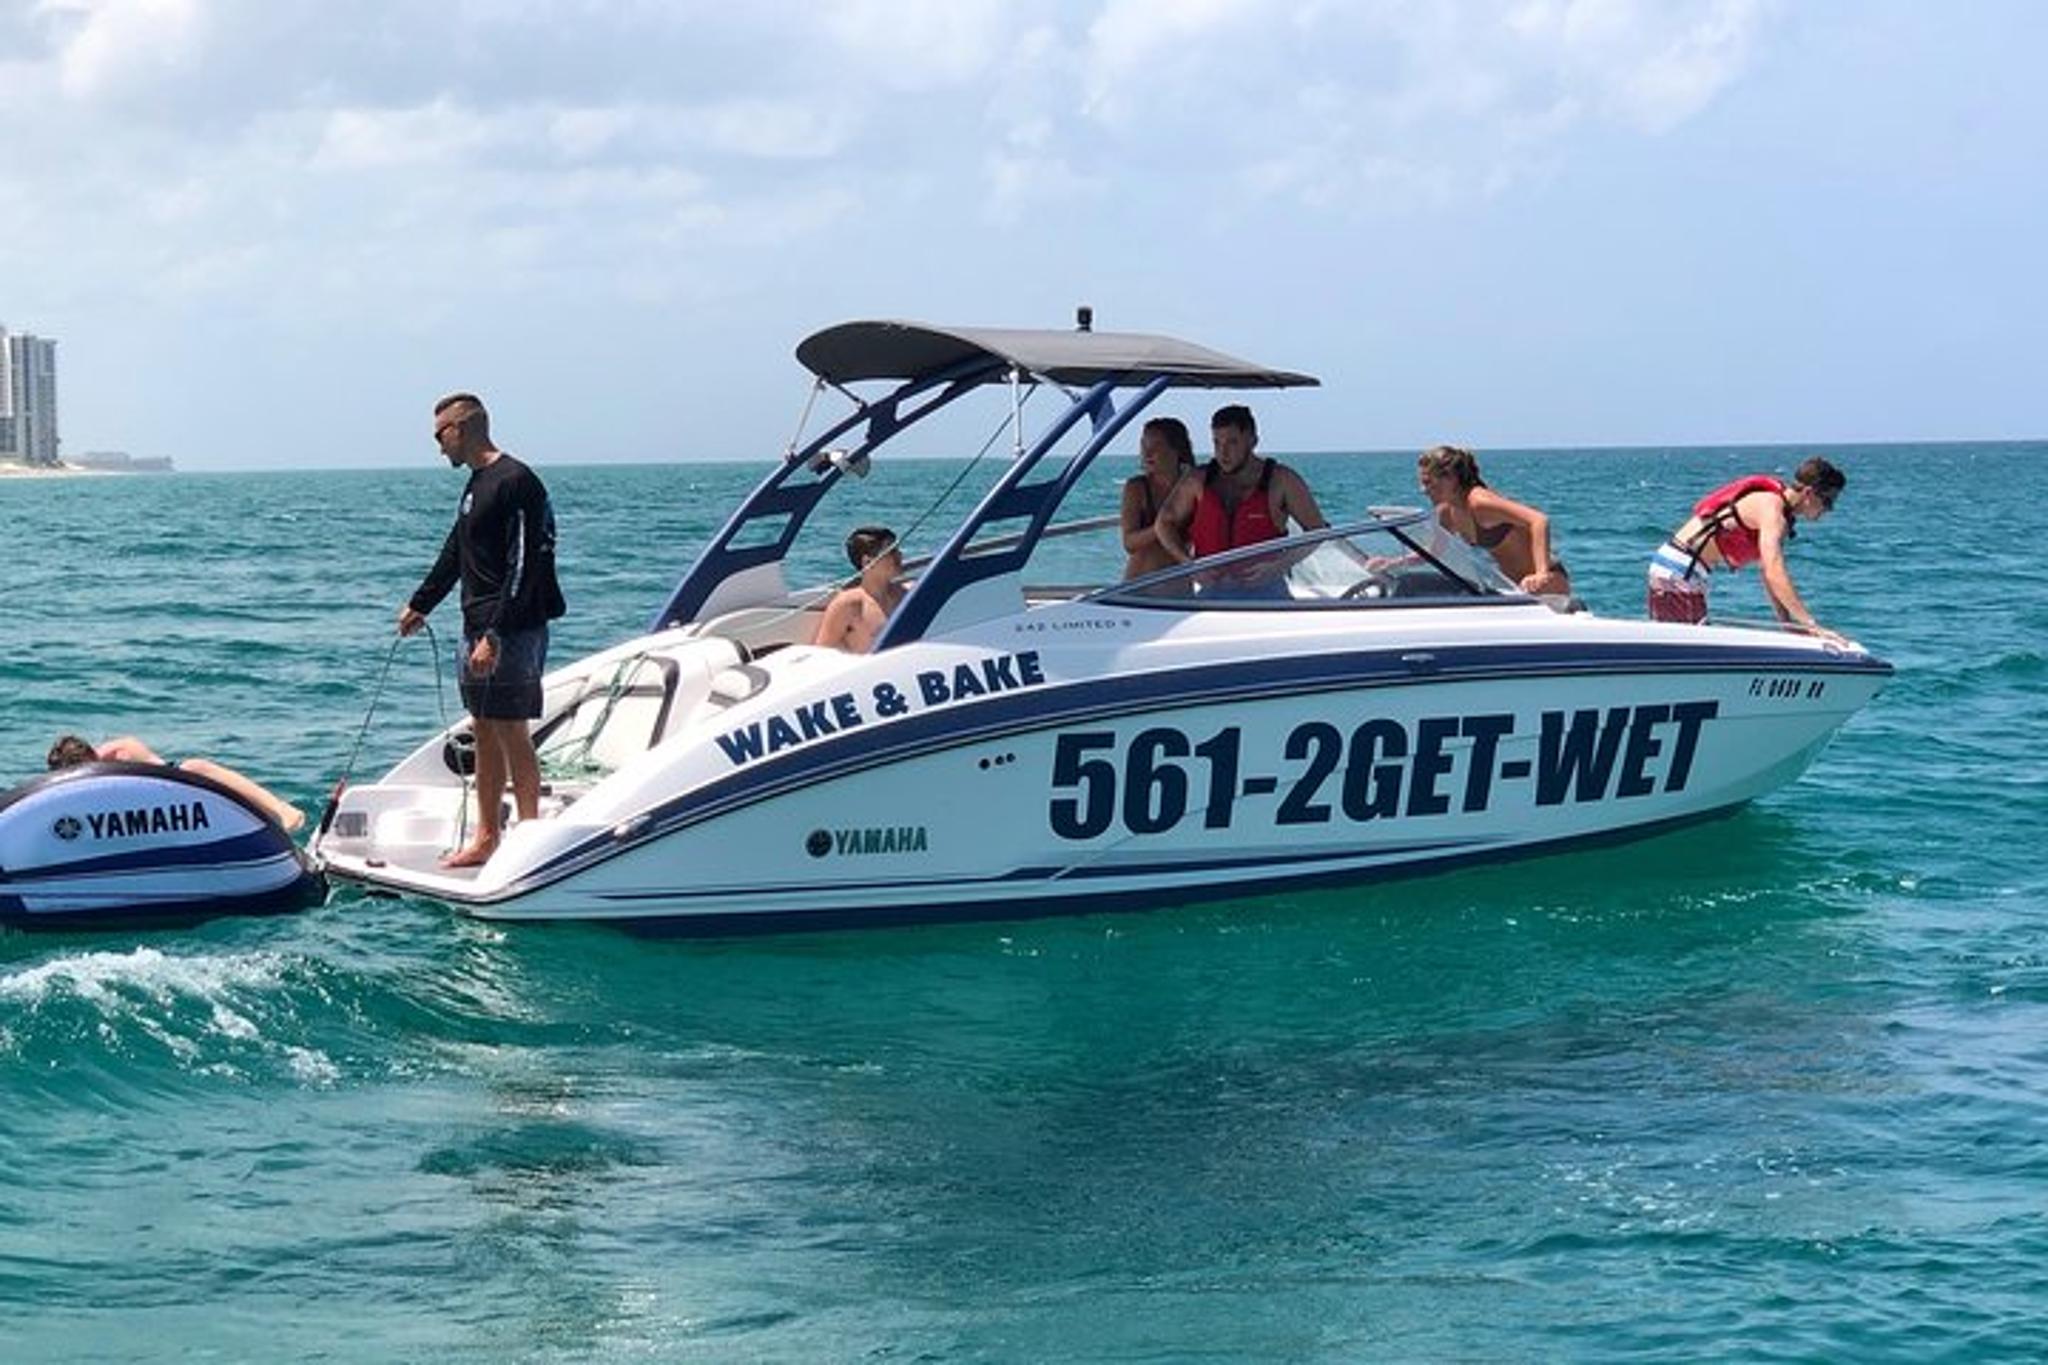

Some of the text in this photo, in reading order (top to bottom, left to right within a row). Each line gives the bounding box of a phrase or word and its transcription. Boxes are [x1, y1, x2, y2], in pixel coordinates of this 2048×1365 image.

[1749, 677, 1765, 697] FL
[714, 650, 1046, 767] WAKE & BAKE
[1049, 700, 1720, 840] 561-2GET-WET
[86, 801, 209, 839] YAMAHA
[834, 826, 928, 855] YAMAHA
